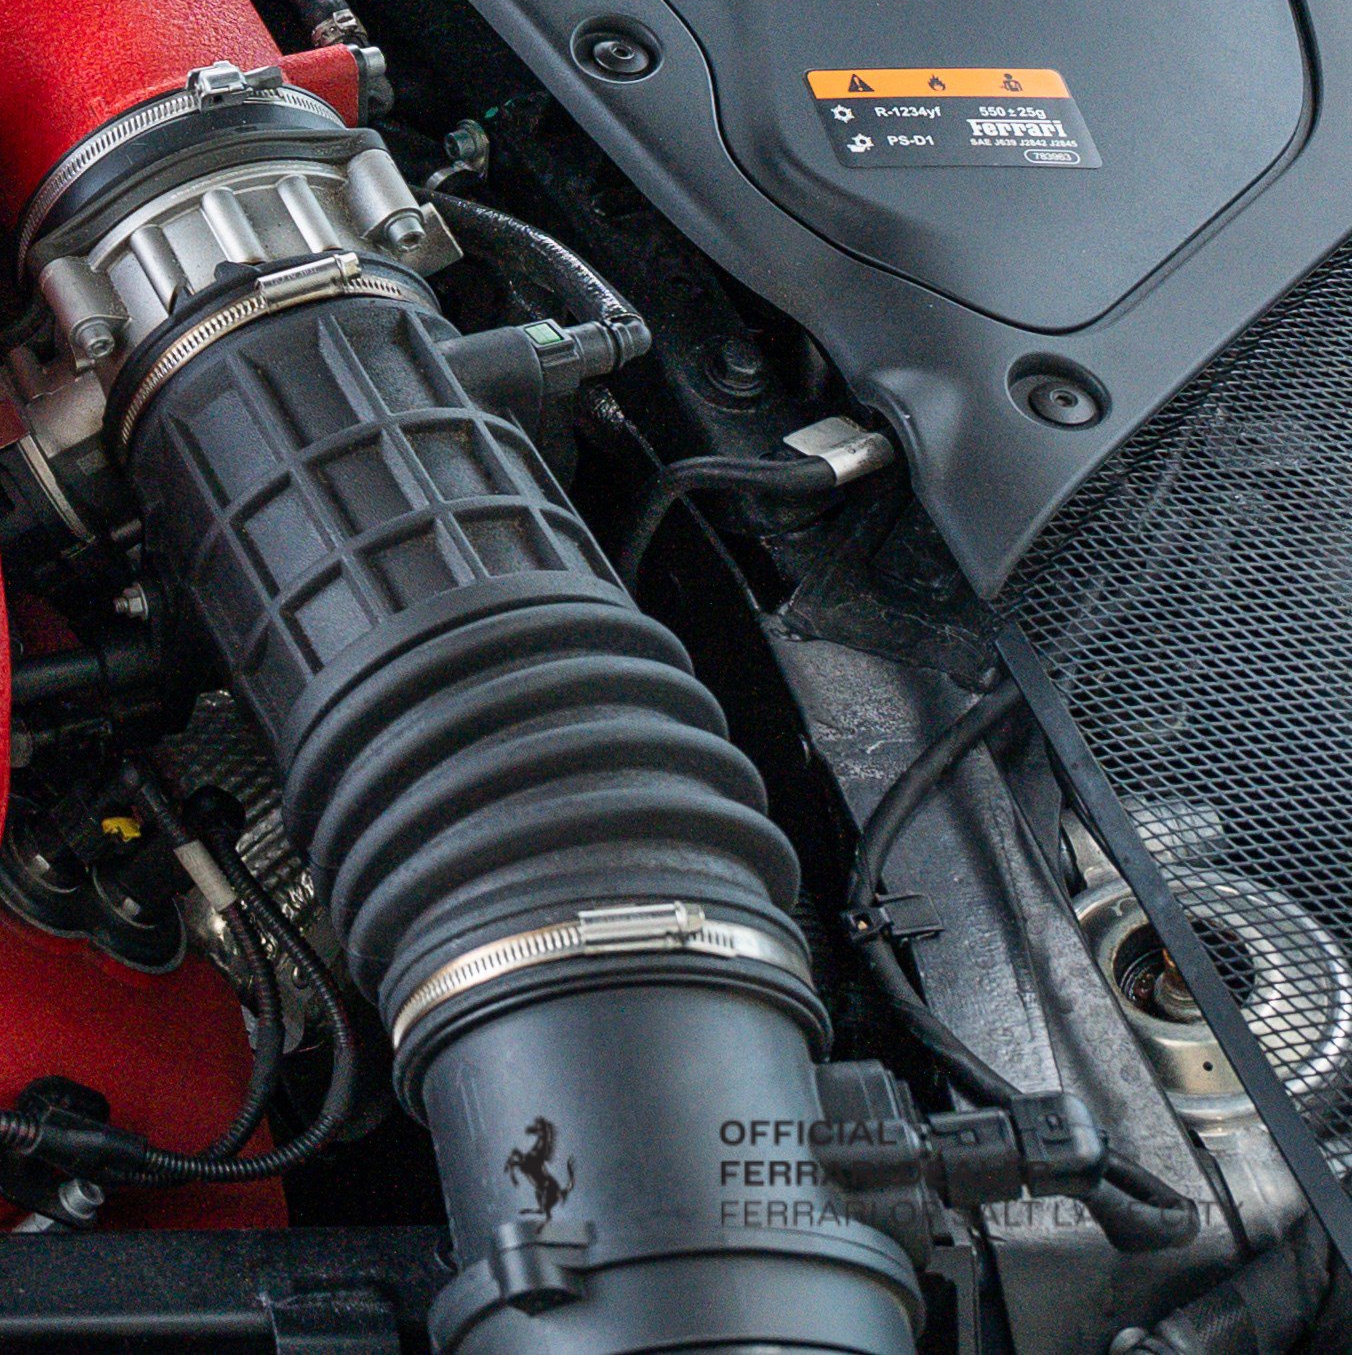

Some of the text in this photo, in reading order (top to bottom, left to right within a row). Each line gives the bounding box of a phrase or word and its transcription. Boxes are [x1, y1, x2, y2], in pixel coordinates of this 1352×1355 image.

[874, 106, 942, 119] R-1234yf
[966, 119, 1068, 137] Ferrari
[886, 135, 935, 146] PS-D1
[970, 138, 992, 146] SAE
